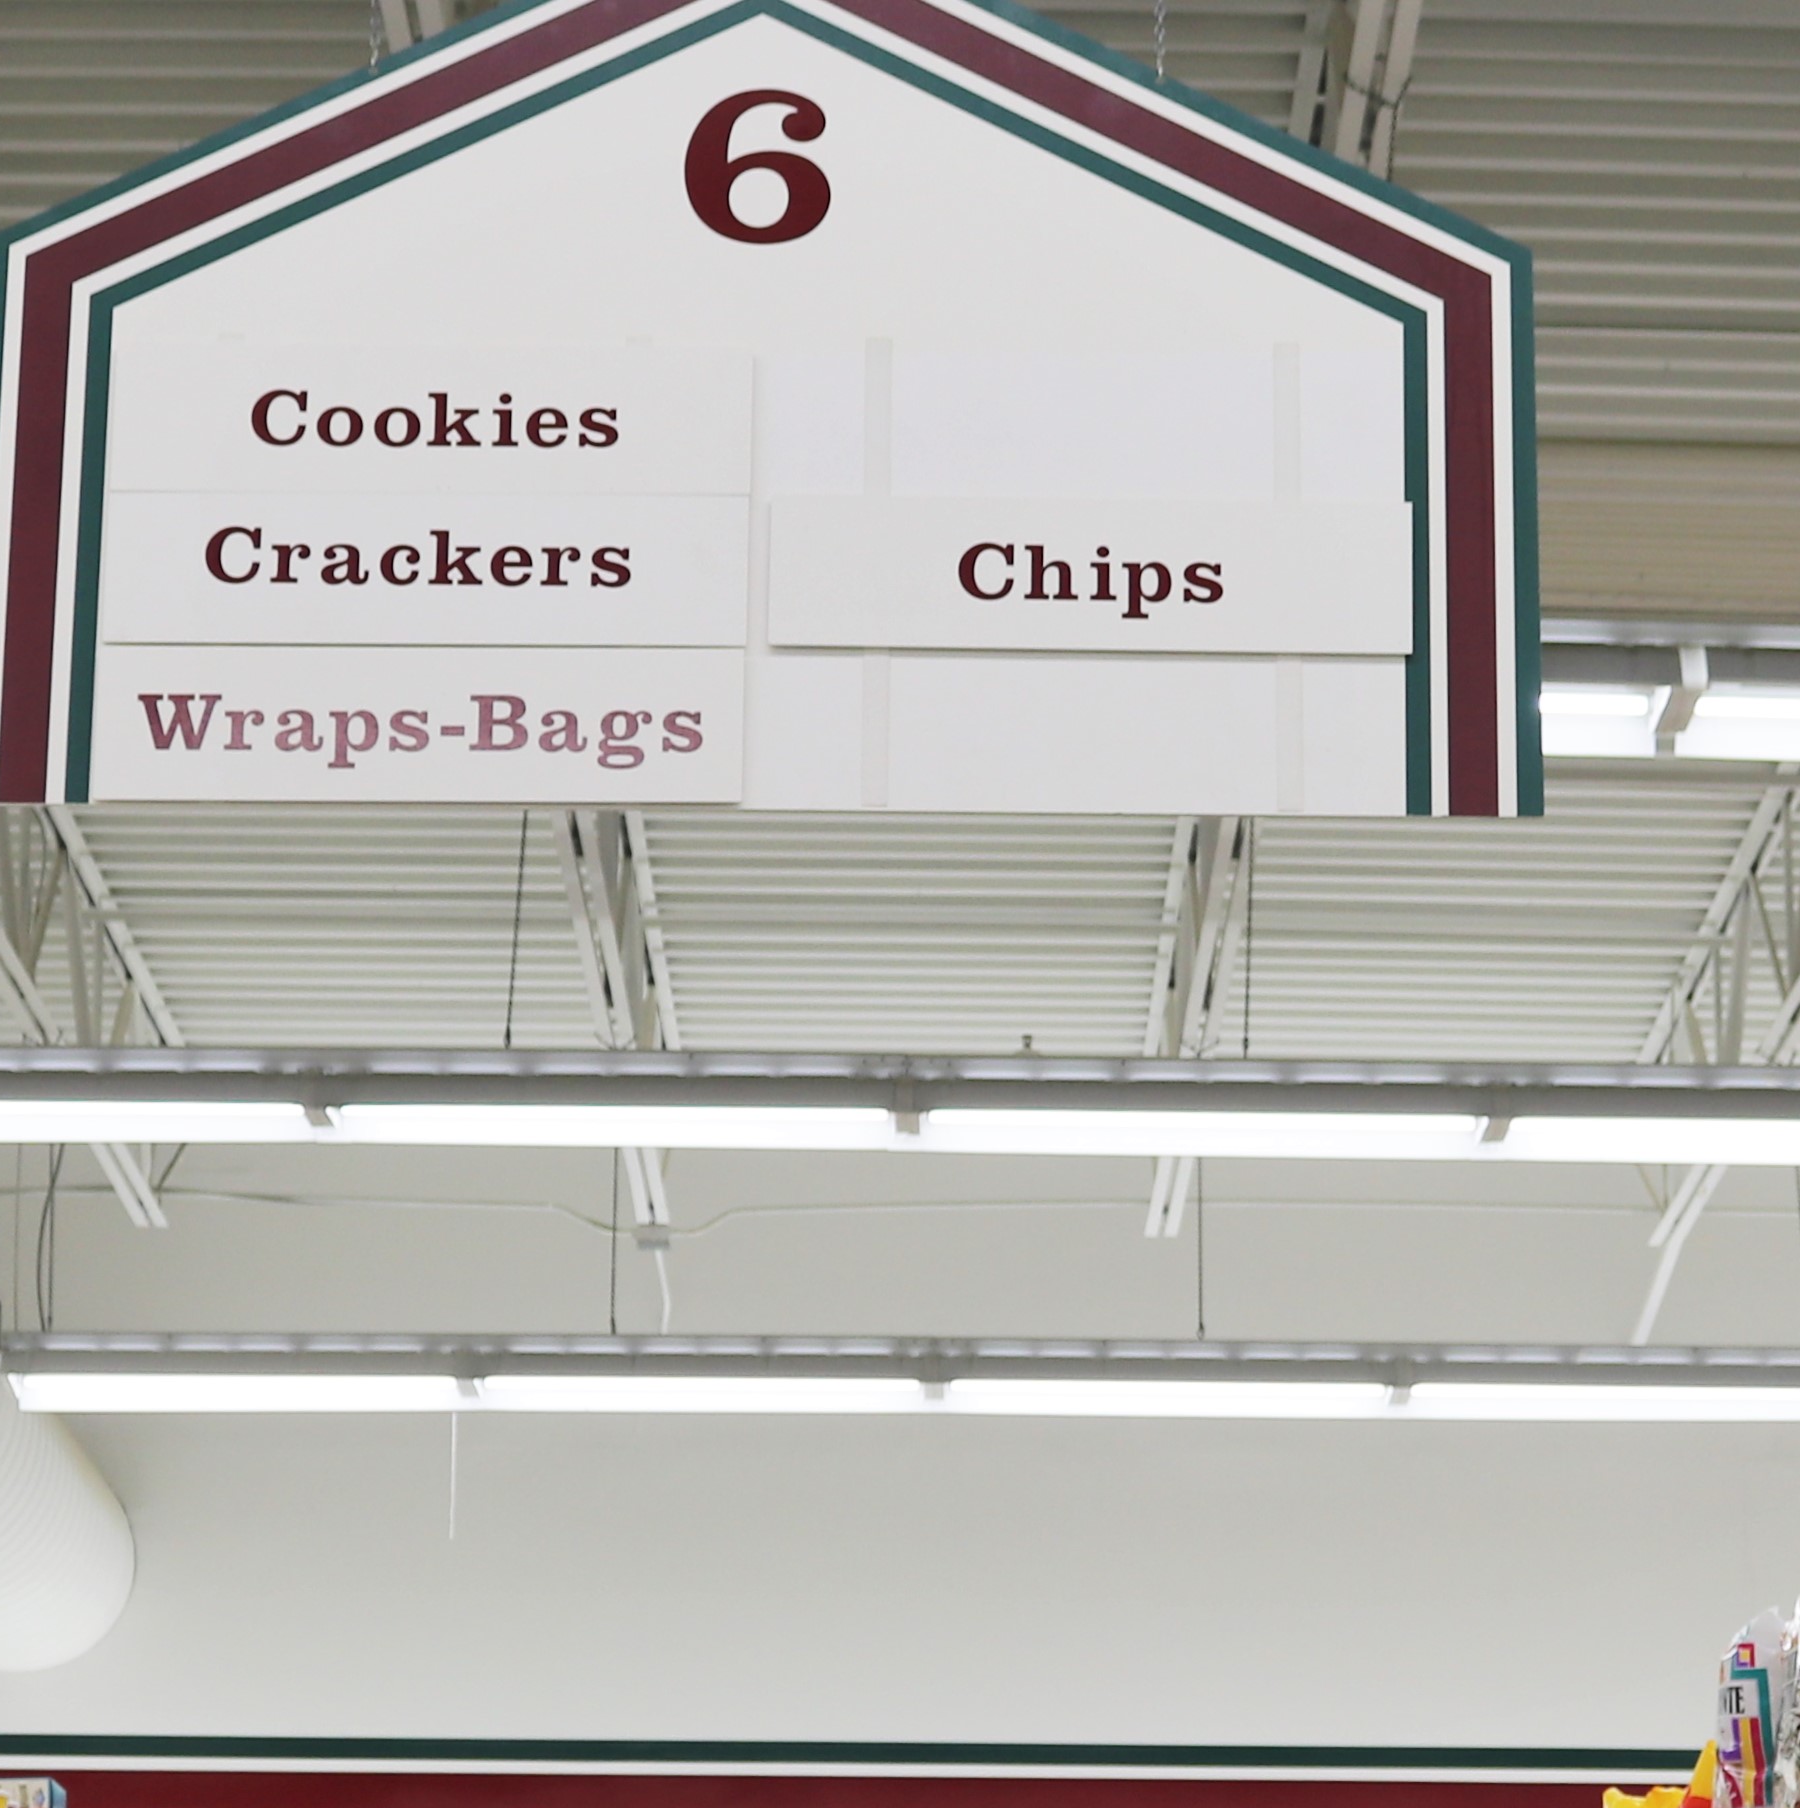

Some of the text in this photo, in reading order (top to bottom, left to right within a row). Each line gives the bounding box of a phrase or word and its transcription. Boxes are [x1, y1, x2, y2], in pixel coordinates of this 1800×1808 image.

[684, 89, 831, 245] 6
[251, 389, 621, 450] Cookies
[204, 527, 633, 588] Crackers
[957, 541, 1226, 619] Chips
[138, 693, 705, 771] Wraps-Bags
